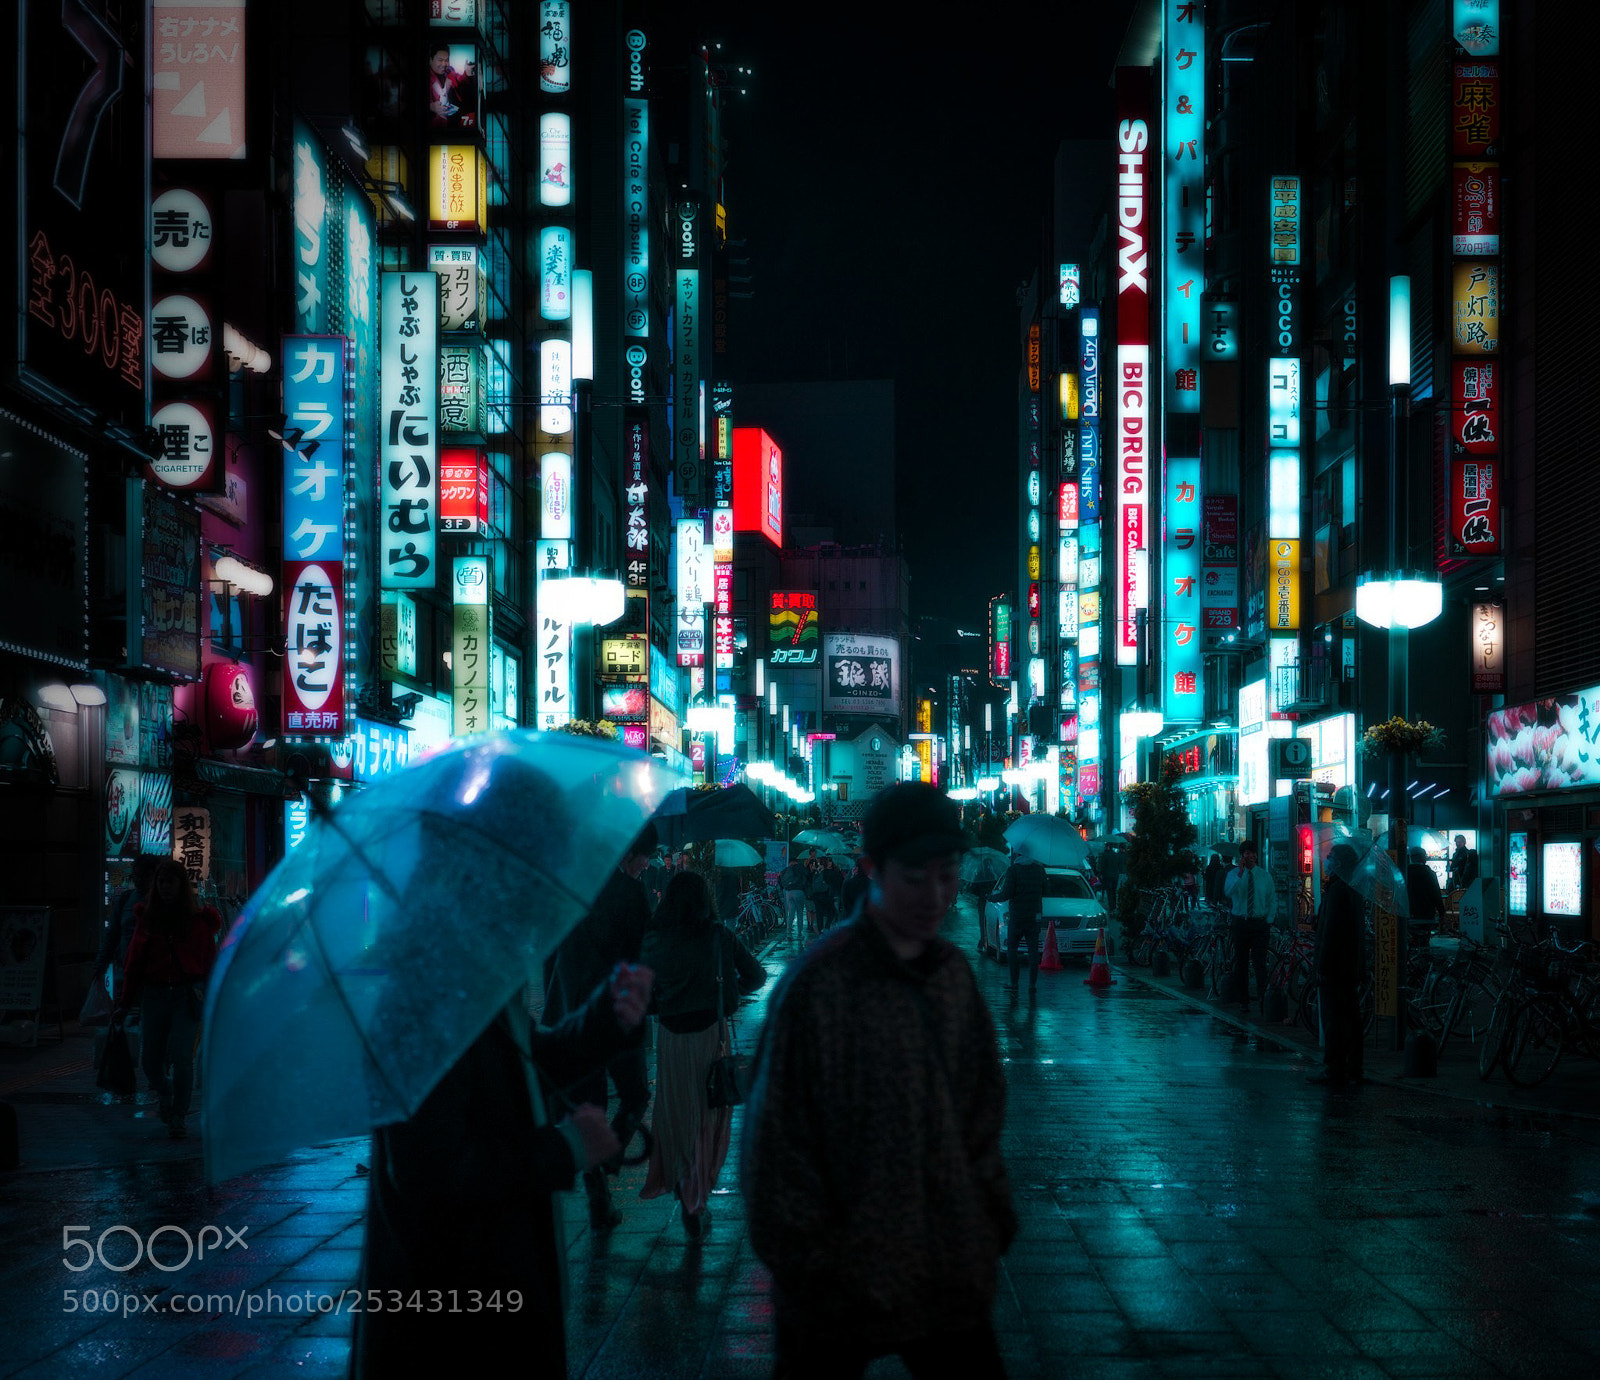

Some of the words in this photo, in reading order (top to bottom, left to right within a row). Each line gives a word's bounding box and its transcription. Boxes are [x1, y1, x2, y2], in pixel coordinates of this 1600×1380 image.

[160, 16, 241, 38] 右ナナメ
[1478, 25, 1496, 43] 奏
[160, 43, 241, 64] うしろへ!
[625, 29, 646, 92] Booth
[461, 115, 474, 127] 7F
[630, 109, 641, 136] Net
[1455, 81, 1495, 144] 麻雀
[630, 141, 642, 179] Cafe
[1472, 163, 1481, 171] 5F
[450, 153, 465, 213] 鳥貴族
[631, 186, 642, 194] &
[1118, 119, 1149, 295] SHIDAX
[153, 210, 190, 248] 売
[192, 221, 211, 240] た
[446, 221, 459, 230] 6F
[629, 202, 642, 265] Capsule
[678, 201, 697, 258] Booth
[434, 249, 472, 262] 質・買取
[1456, 242, 1482, 252] 270円
[682, 277, 693, 348] ネットカフェ
[1278, 284, 1292, 347] COCO
[1467, 267, 1488, 344] 戸灯路
[153, 317, 190, 355] 香
[192, 327, 210, 345] ば
[464, 320, 476, 330] 5F
[399, 275, 420, 406] しゃぶしゃぶ
[1482, 340, 1497, 350] 4F
[683, 355, 692, 366] &
[626, 345, 648, 404] Booth
[1122, 361, 1143, 410] BIC
[1463, 367, 1478, 397] 焼鳥
[461, 386, 470, 394] 4F
[683, 371, 693, 419] カプセル
[1273, 375, 1288, 440] ココ
[1462, 398, 1492, 443] 一休
[194, 435, 210, 452] こ
[285, 343, 345, 558] カラオケ
[1454, 444, 1465, 453] 3F
[1082, 429, 1094, 497] SHINJUKU
[1122, 416, 1143, 496] DRUG
[155, 463, 206, 474] CIGARETTE
[1463, 464, 1477, 498] 居酒屋
[388, 409, 430, 578] にいむら
[445, 519, 463, 529] 3F
[626, 482, 649, 552] 甘太郎
[1127, 507, 1138, 531] BIC
[1462, 499, 1492, 543] 一休
[1206, 546, 1236, 558] Cafe
[1454, 543, 1465, 552] 2F
[461, 566, 481, 583] 質
[628, 561, 647, 573] 4F
[628, 574, 647, 586] 3F
[1174, 480, 1197, 695] カラオケ館
[772, 592, 815, 608] 質・買取
[1209, 617, 1232, 625] 729
[298, 582, 342, 691] たばこ
[541, 617, 564, 702] ルノアール
[607, 651, 641, 663] ロード
[682, 656, 699, 667] B1
[771, 648, 817, 662] カワノ
[836, 645, 888, 656] 売るのも買うのも
[287, 711, 339, 729] 直売所
[354, 723, 407, 775] カラオケ
